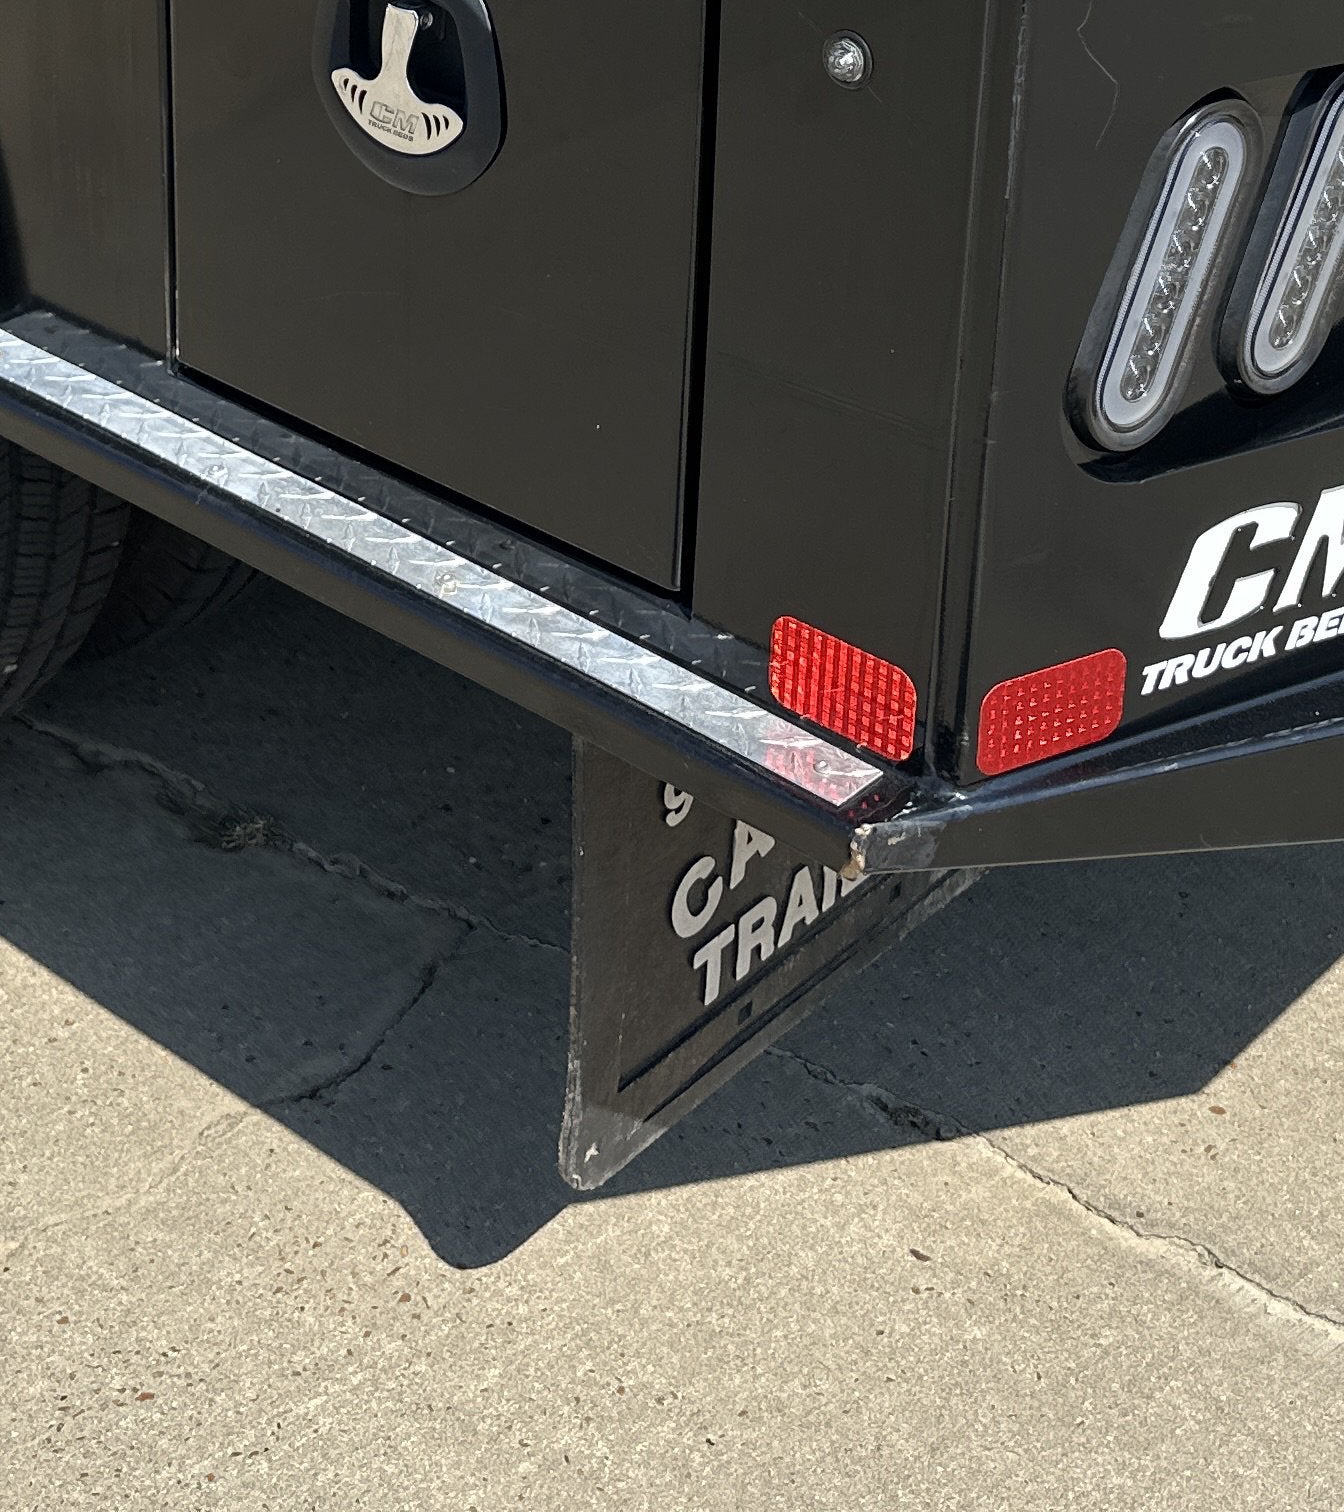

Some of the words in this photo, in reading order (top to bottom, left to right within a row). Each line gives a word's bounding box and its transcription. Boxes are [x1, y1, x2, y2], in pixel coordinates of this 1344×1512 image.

[367, 118, 393, 133] TRUCK
[392, 129, 414, 141] BEDS
[369, 101, 419, 134] CM
[1141, 625, 1285, 696] TRUCK
